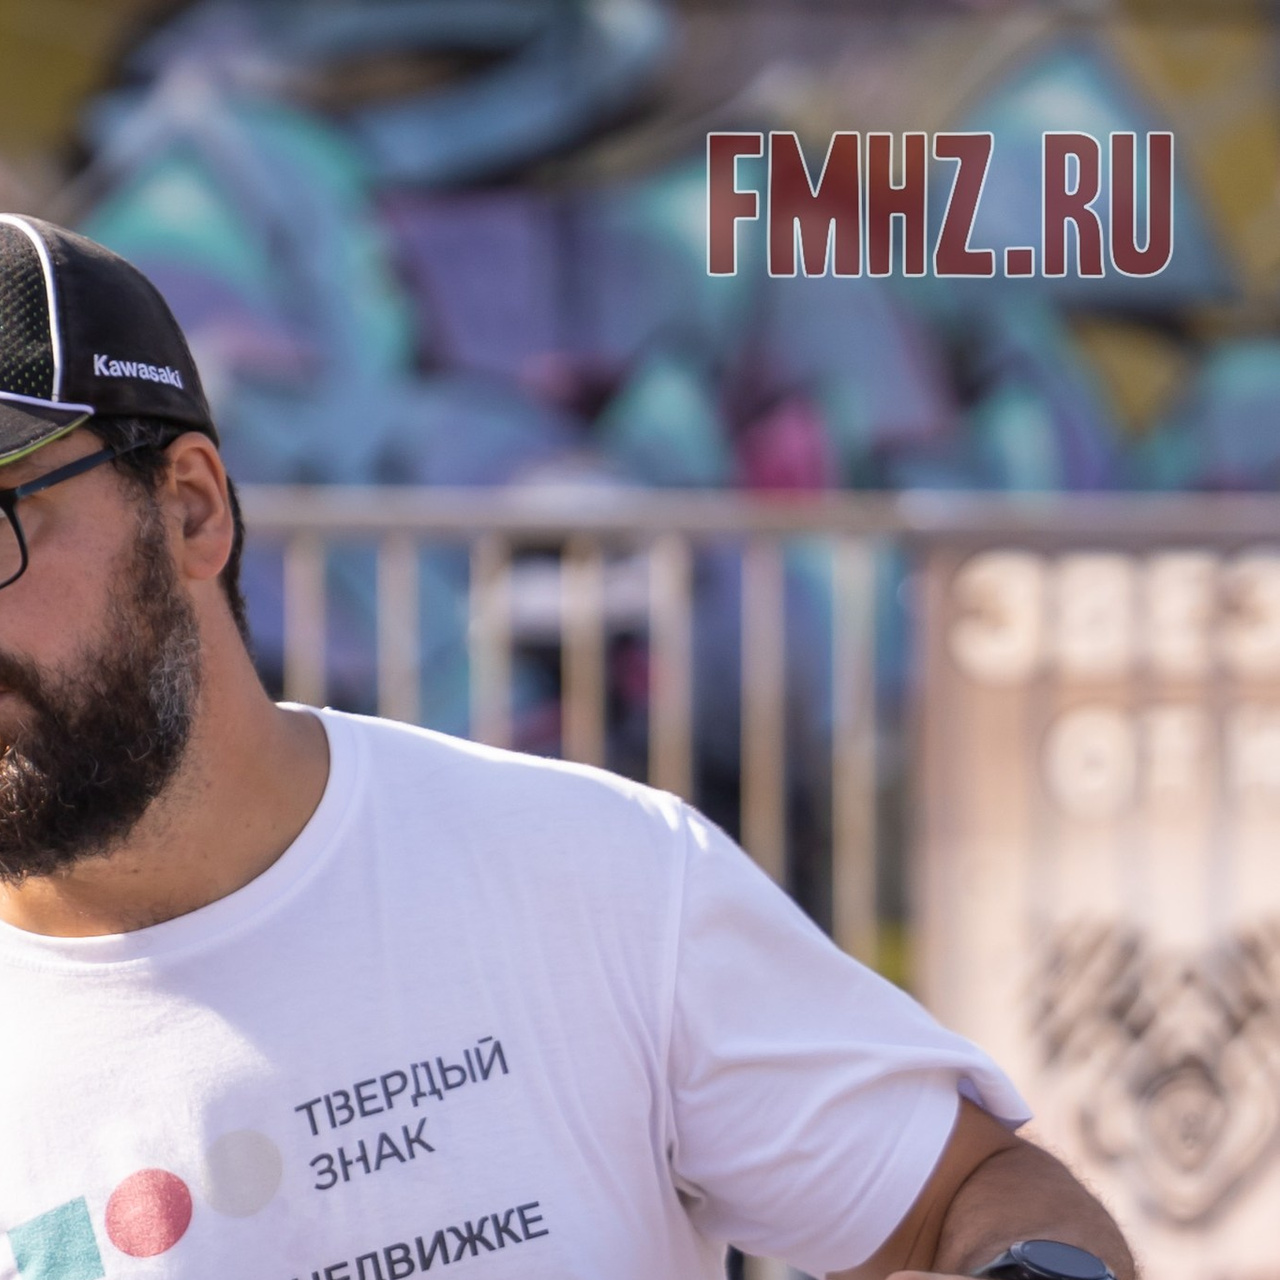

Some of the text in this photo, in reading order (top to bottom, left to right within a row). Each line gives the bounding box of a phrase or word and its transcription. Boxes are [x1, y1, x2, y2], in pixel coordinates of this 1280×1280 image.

[92, 353, 184, 390] Kawasaki
[294, 1036, 511, 1137] ТВЕРДЫЙ
[308, 1117, 436, 1191] ЗНАК
